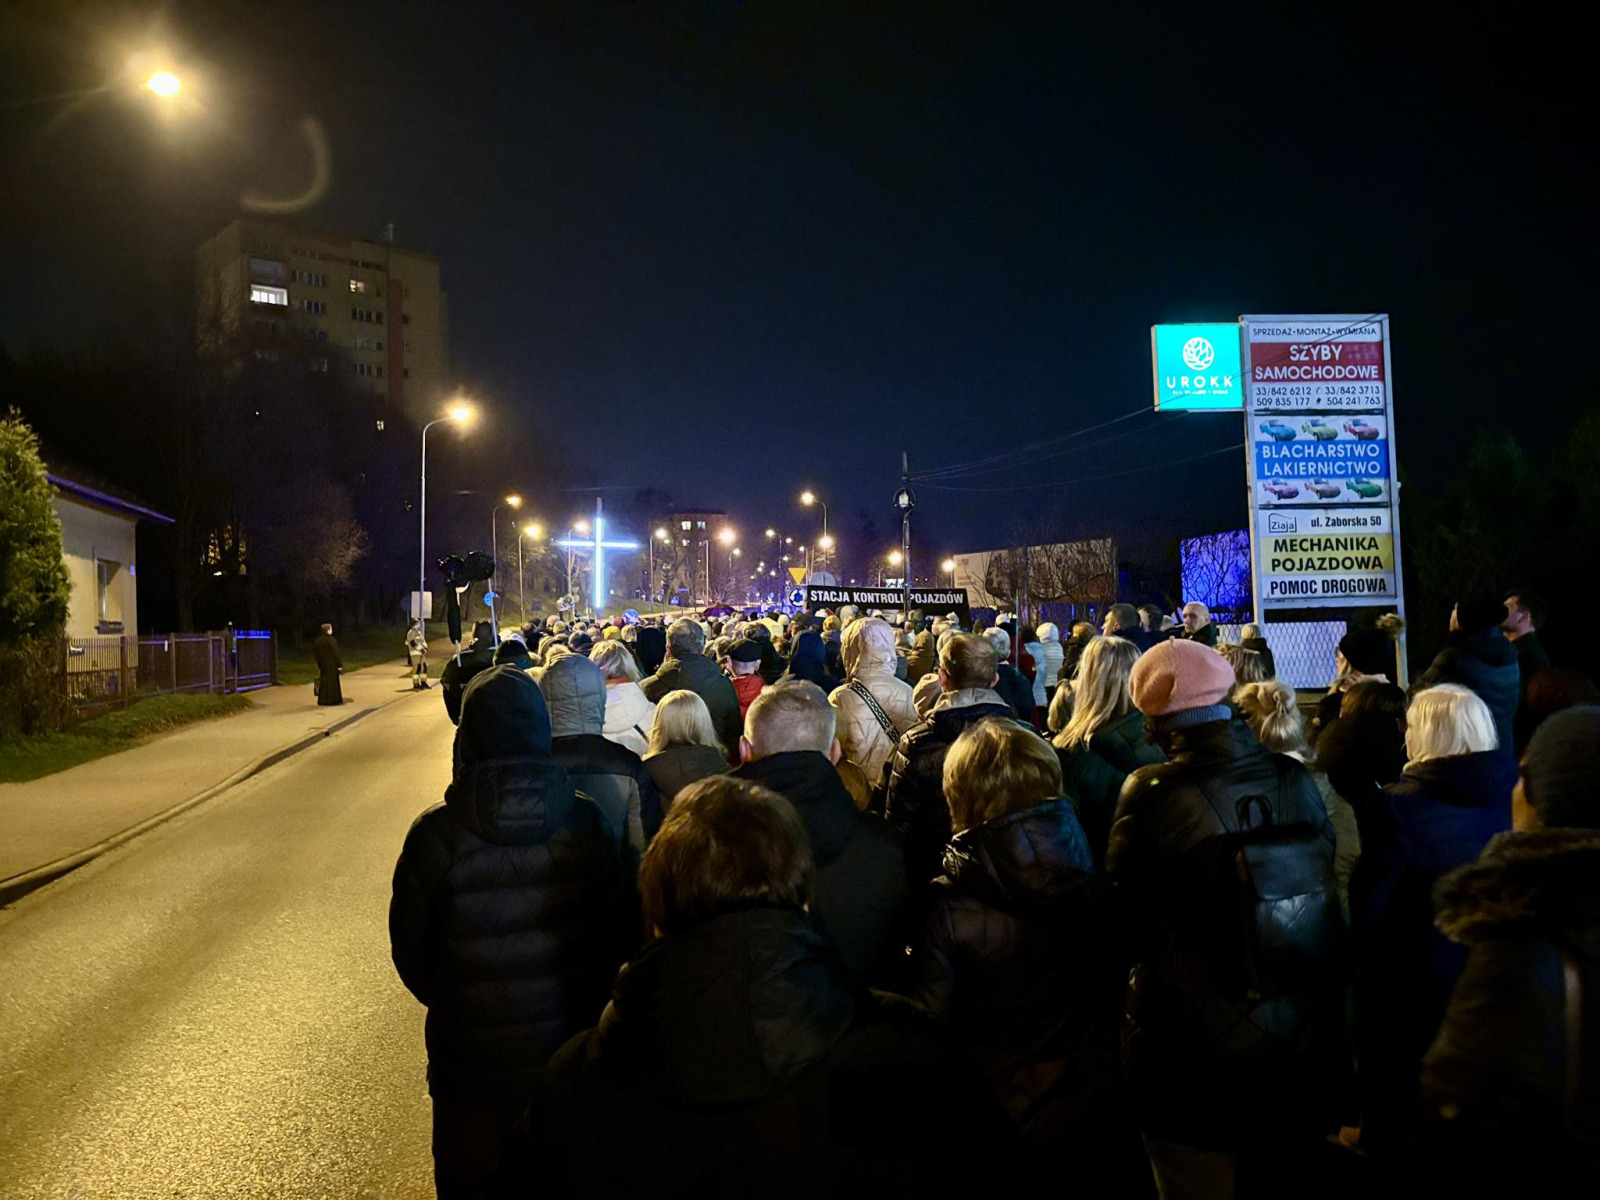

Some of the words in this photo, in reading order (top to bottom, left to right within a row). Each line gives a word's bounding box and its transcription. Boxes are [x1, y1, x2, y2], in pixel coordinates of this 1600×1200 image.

[1252, 325, 1292, 336] SPRZEDAŻ
[1296, 325, 1332, 336] MONTAŻ
[1335, 327, 1377, 336] WYMIANA
[1289, 344, 1342, 361] SZYBY
[1255, 365, 1379, 380] SAMOCHODOWE
[1166, 375, 1233, 389] UROKK
[1255, 386, 1287, 396] 33/842
[1289, 386, 1311, 396] 6212
[1325, 386, 1356, 395] 33/842
[1358, 386, 1380, 395] 3713
[1256, 397, 1273, 407] 509
[1275, 397, 1292, 407] 835
[1295, 397, 1310, 406] 177
[1327, 396, 1343, 406] 504
[1345, 396, 1361, 406] 241
[1365, 396, 1381, 405] 763
[1262, 443, 1380, 459] BLACHARSTWO
[1264, 460, 1381, 476] LAKIERNICTWO
[1270, 518, 1296, 533] Ziaja
[1311, 517, 1323, 528] ul.
[1325, 516, 1368, 528] Zaborska
[1370, 515, 1382, 526] 50
[1273, 537, 1379, 553] MECHANIKA
[1271, 556, 1383, 572] POJAZDOWA
[1270, 579, 1317, 595] POMOC
[1322, 578, 1387, 594] DROGOWA
[810, 590, 850, 603] STACJA
[853, 592, 904, 604] KONTROLI
